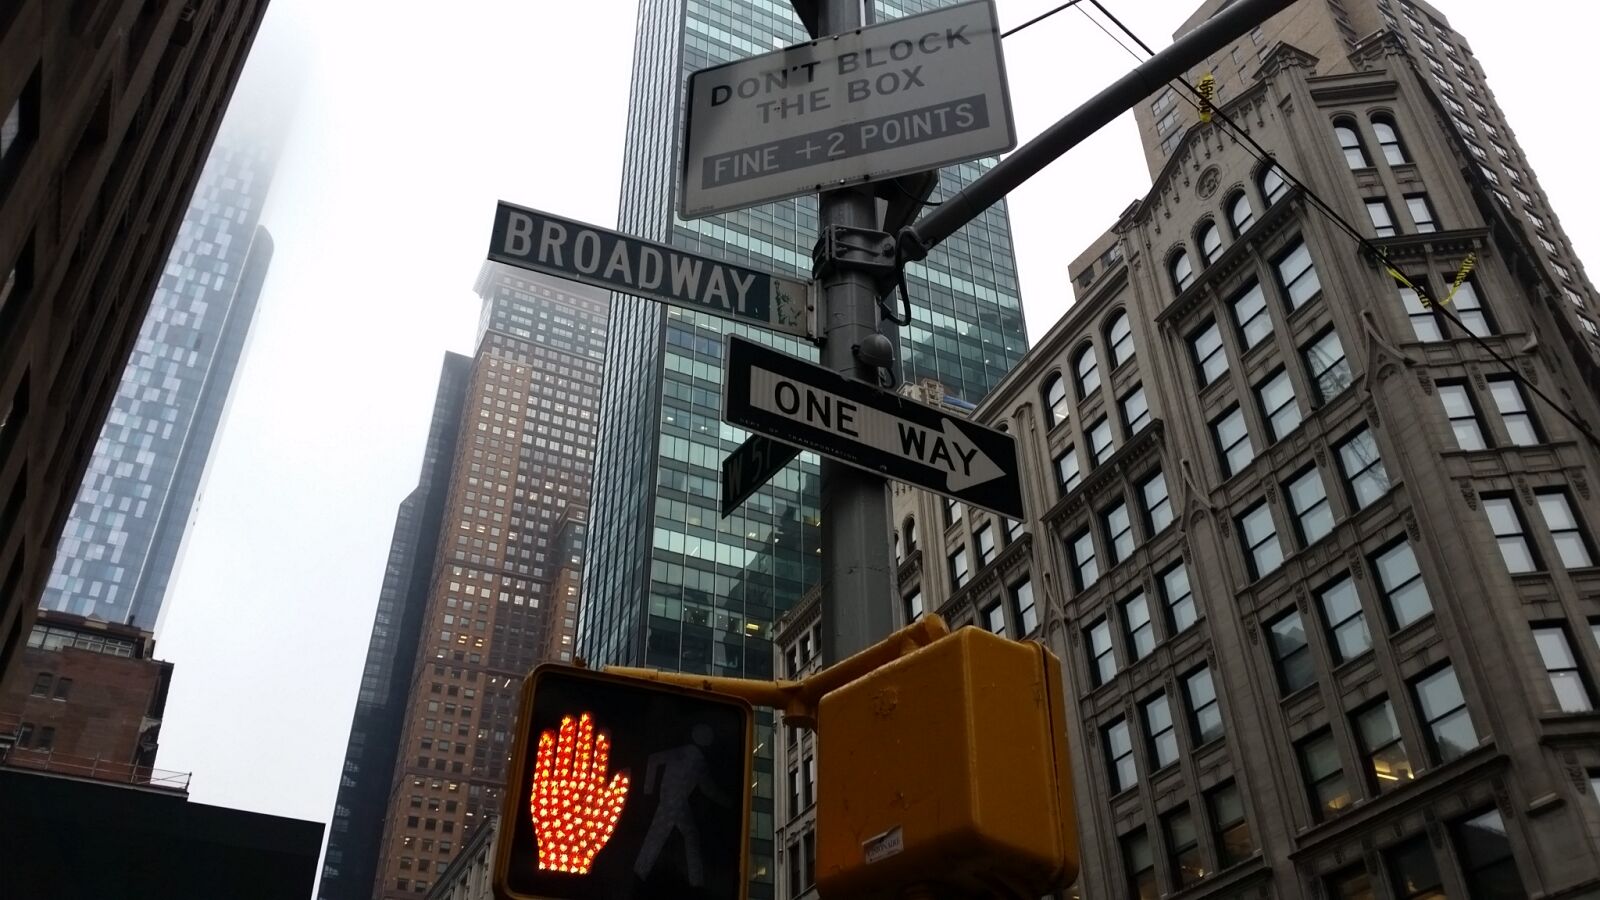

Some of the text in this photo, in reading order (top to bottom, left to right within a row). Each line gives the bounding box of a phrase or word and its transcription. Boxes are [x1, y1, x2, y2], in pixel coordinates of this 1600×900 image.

[712, 24, 972, 107] DON'T BLOCK
[757, 66, 926, 124] THE BOX
[714, 147, 780, 182] FINE
[796, 132, 846, 160] +2
[861, 103, 976, 149] POINTS
[503, 211, 756, 312] BROADWAY
[774, 381, 978, 477] ONE WAY
[728, 452, 744, 501] W
